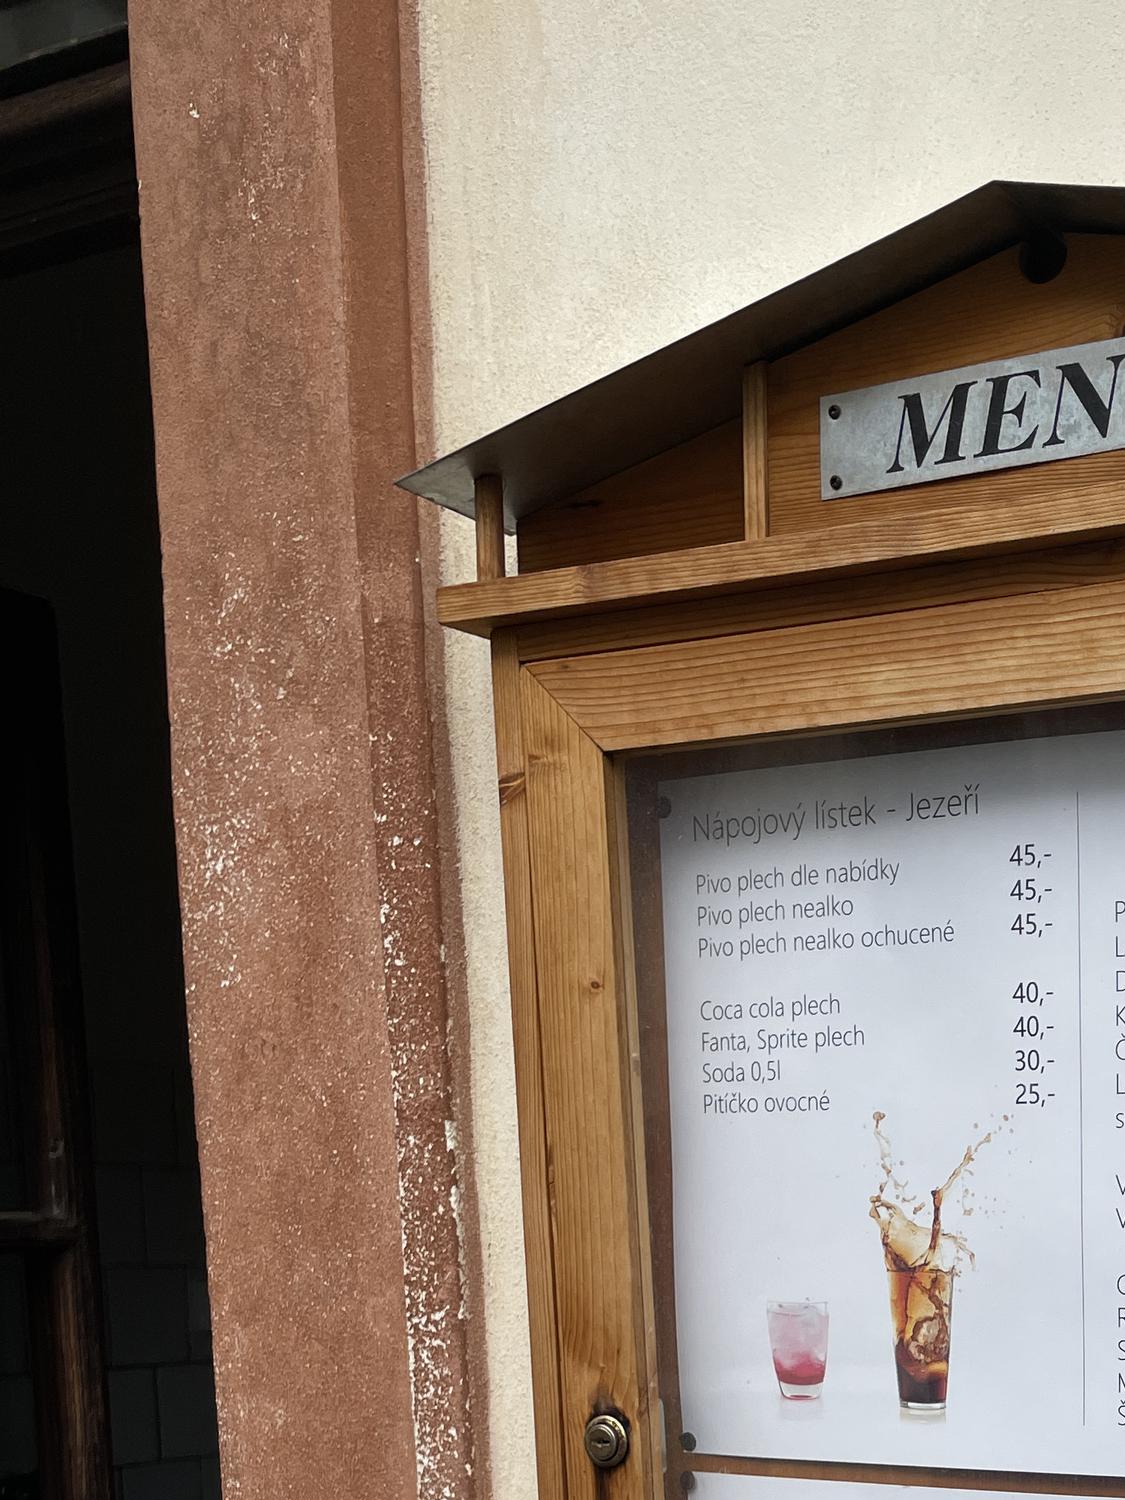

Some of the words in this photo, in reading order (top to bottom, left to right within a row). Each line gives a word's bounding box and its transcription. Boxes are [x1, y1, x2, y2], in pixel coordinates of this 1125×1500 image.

[692, 801, 806, 846] Nápojový
[815, 796, 876, 831] lístek
[905, 784, 981, 821] Jezeří
[696, 873, 732, 895] Pivo
[738, 868, 784, 896] plech
[790, 864, 818, 887] dle
[825, 859, 899, 885] nabídky
[1009, 844, 1052, 869] 45,-
[697, 905, 733, 926] Pivo
[739, 900, 785, 928] plech
[792, 896, 854, 920] nealko
[1010, 879, 1052, 903] 45,-
[739, 932, 787, 960] plech
[793, 929, 854, 952] nealko
[861, 920, 955, 947] ochucené
[1010, 914, 1053, 938] 45,-
[700, 999, 743, 1021] Coca
[748, 997, 785, 1019] cola
[1012, 982, 1054, 1006] 40,-
[701, 1032, 751, 1053] Fanta,
[757, 1029, 808, 1055] Sprite
[1013, 1016, 1054, 1040] 40,-
[702, 1063, 745, 1083] Soda
[1014, 1050, 1055, 1073] 30,-
[703, 1092, 759, 1114] Pitíčko
[764, 1090, 830, 1112] ovocné
[1015, 1084, 1055, 1107] 25,-
